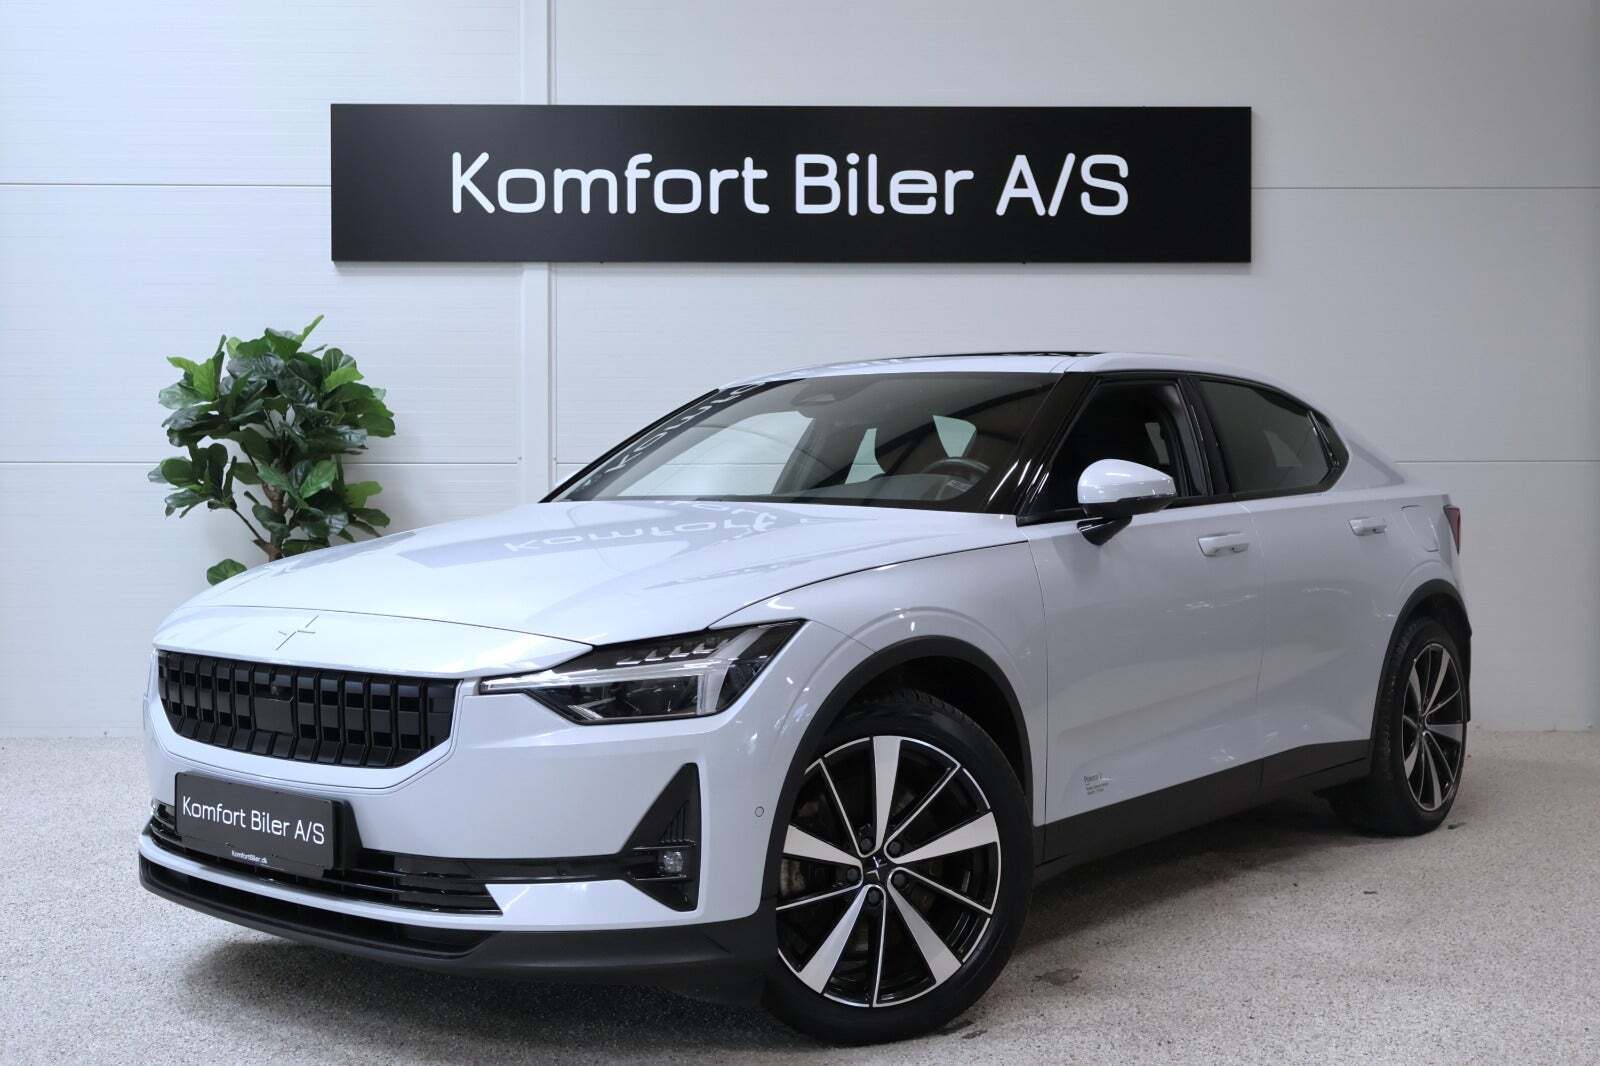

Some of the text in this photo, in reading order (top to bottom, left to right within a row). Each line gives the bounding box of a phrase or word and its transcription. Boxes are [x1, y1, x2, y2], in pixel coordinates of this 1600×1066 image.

[451, 151, 1129, 217] Komfort Biler A/S
[182, 795, 325, 845] Komfort Biler A/S
